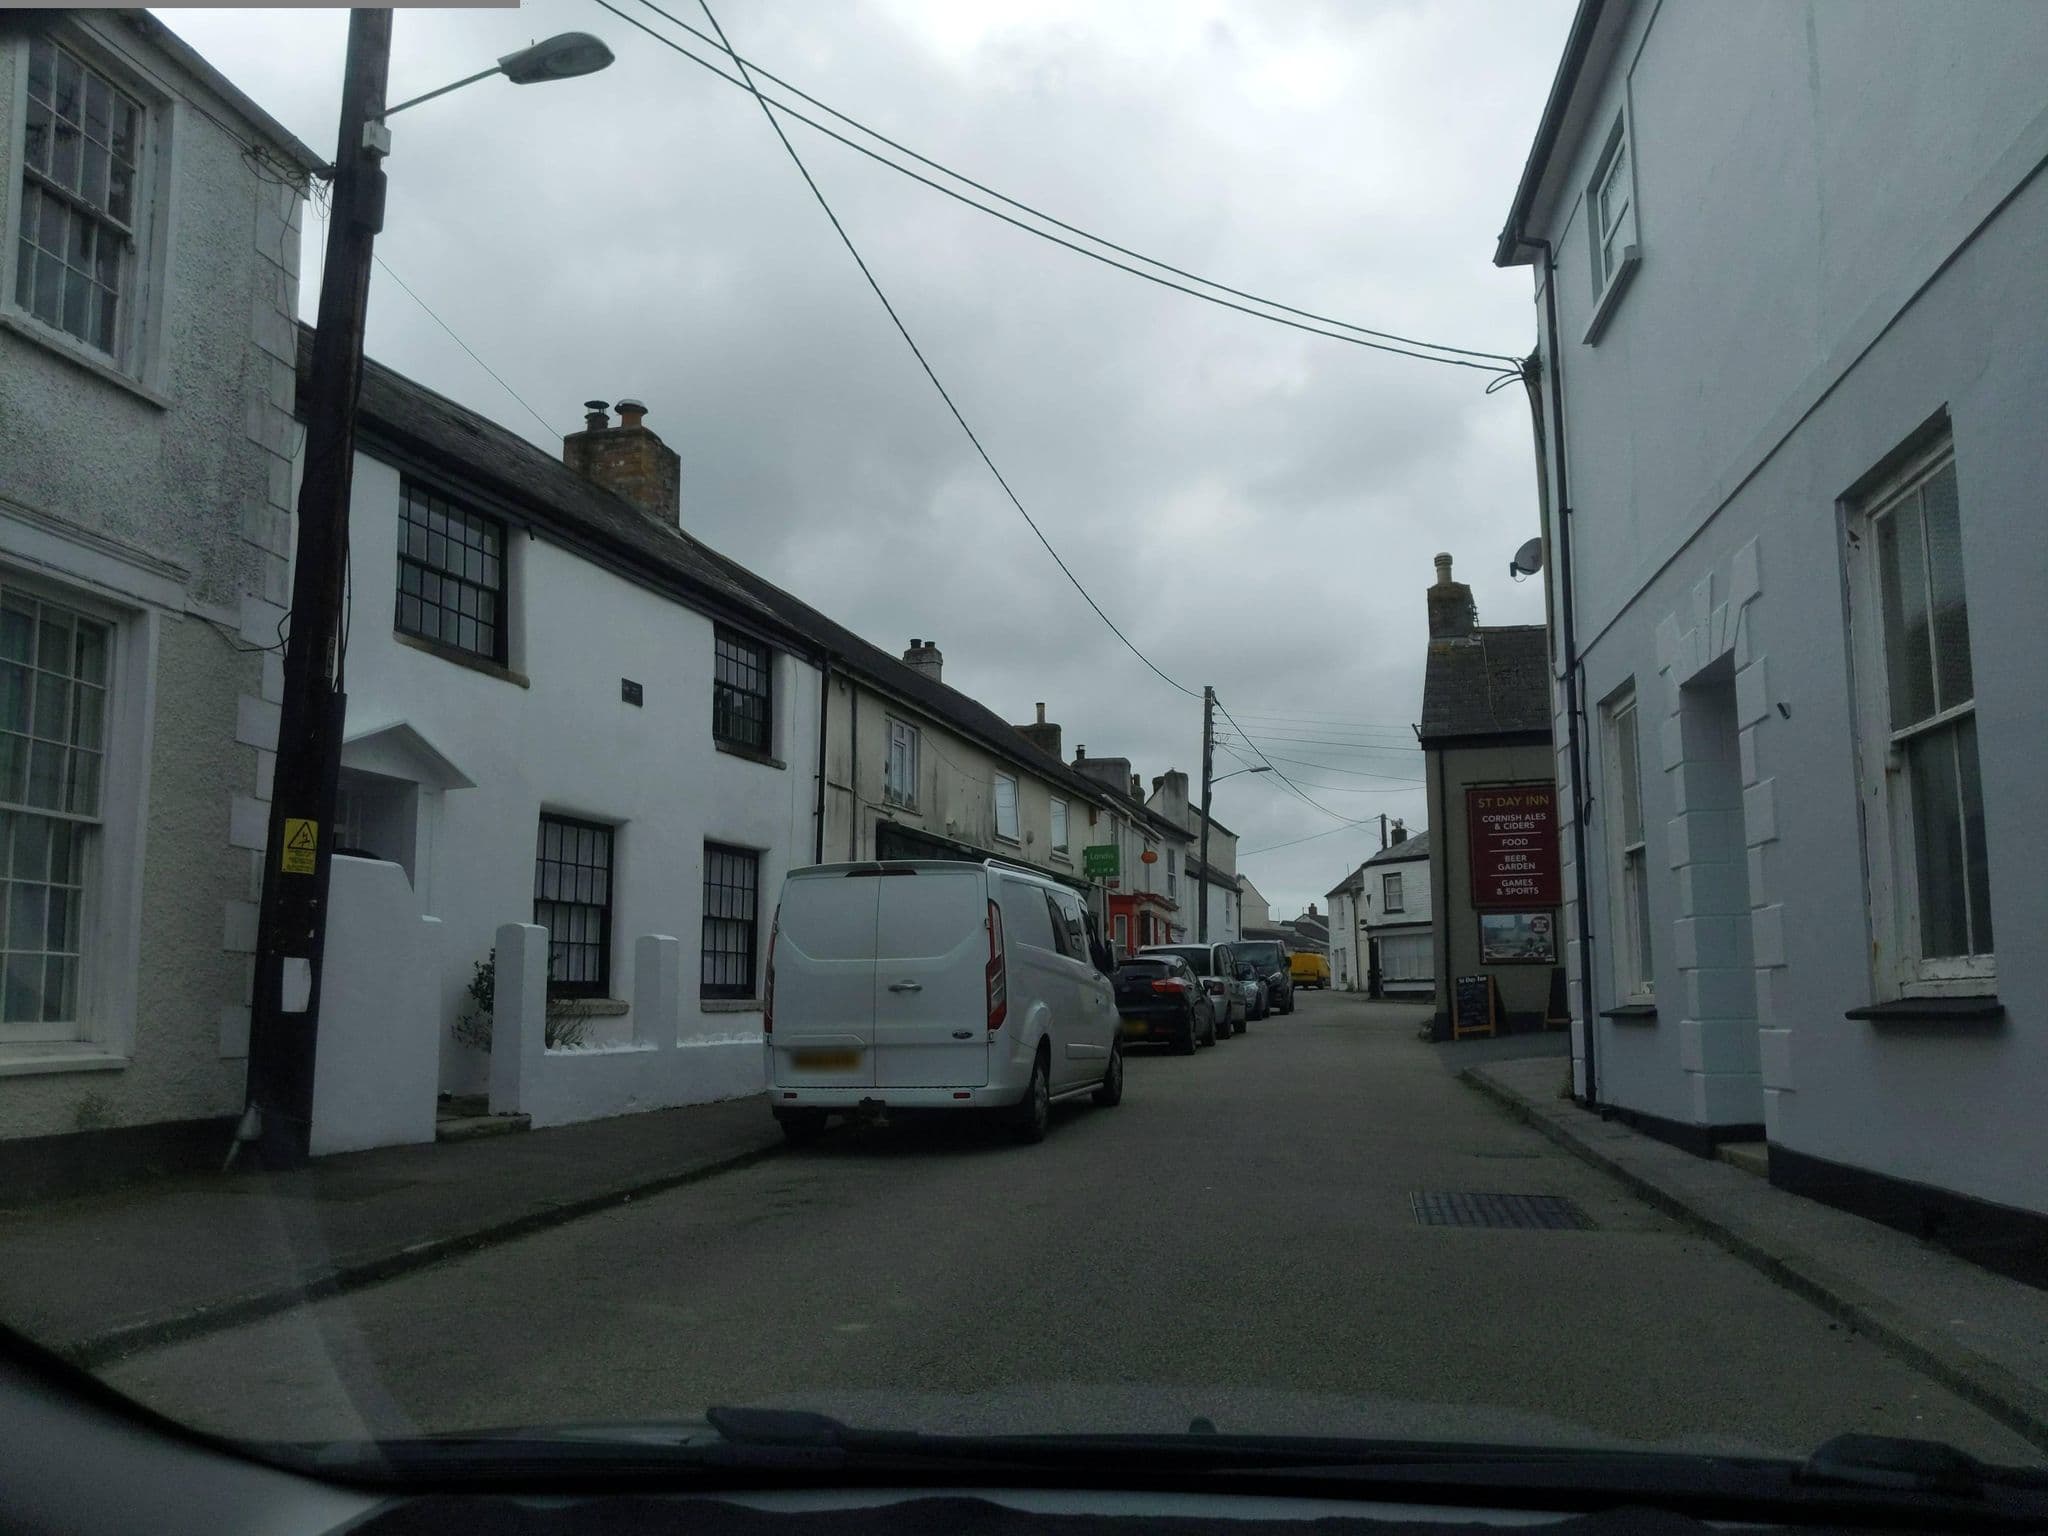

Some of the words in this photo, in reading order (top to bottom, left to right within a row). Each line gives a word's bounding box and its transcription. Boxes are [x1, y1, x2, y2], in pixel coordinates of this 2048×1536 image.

[1479, 798, 1493, 808] ST
[1497, 797, 1521, 807] DAY
[1526, 795, 1549, 806] INN
[1482, 814, 1522, 823] CORNISH
[1525, 813, 1546, 821] ALES
[1503, 821, 1535, 830] CIDERS
[1502, 838, 1528, 847] FOOD
[1498, 862, 1536, 871] GARDEN
[1501, 879, 1534, 887] GAMES
[1506, 886, 1539, 895] SPORTS
